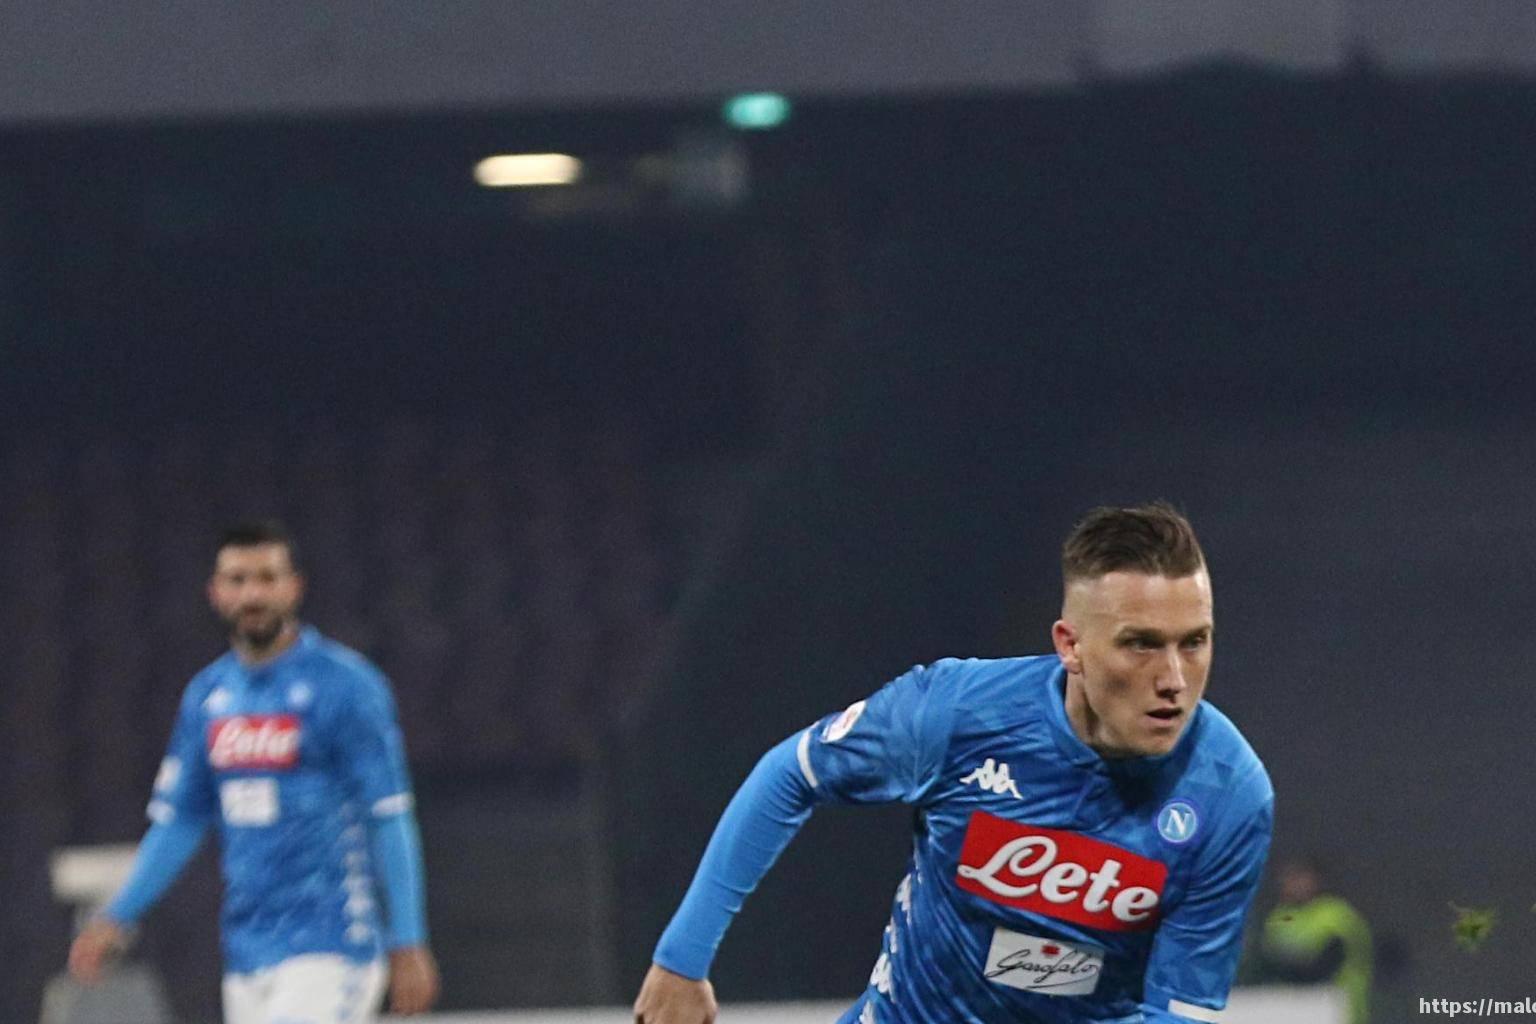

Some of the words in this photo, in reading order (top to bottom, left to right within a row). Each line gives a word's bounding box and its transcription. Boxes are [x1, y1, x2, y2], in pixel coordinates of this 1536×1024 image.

[1165, 808, 1191, 836] N
[957, 835, 1160, 922] Lete
[984, 947, 1101, 989] Garofalo
